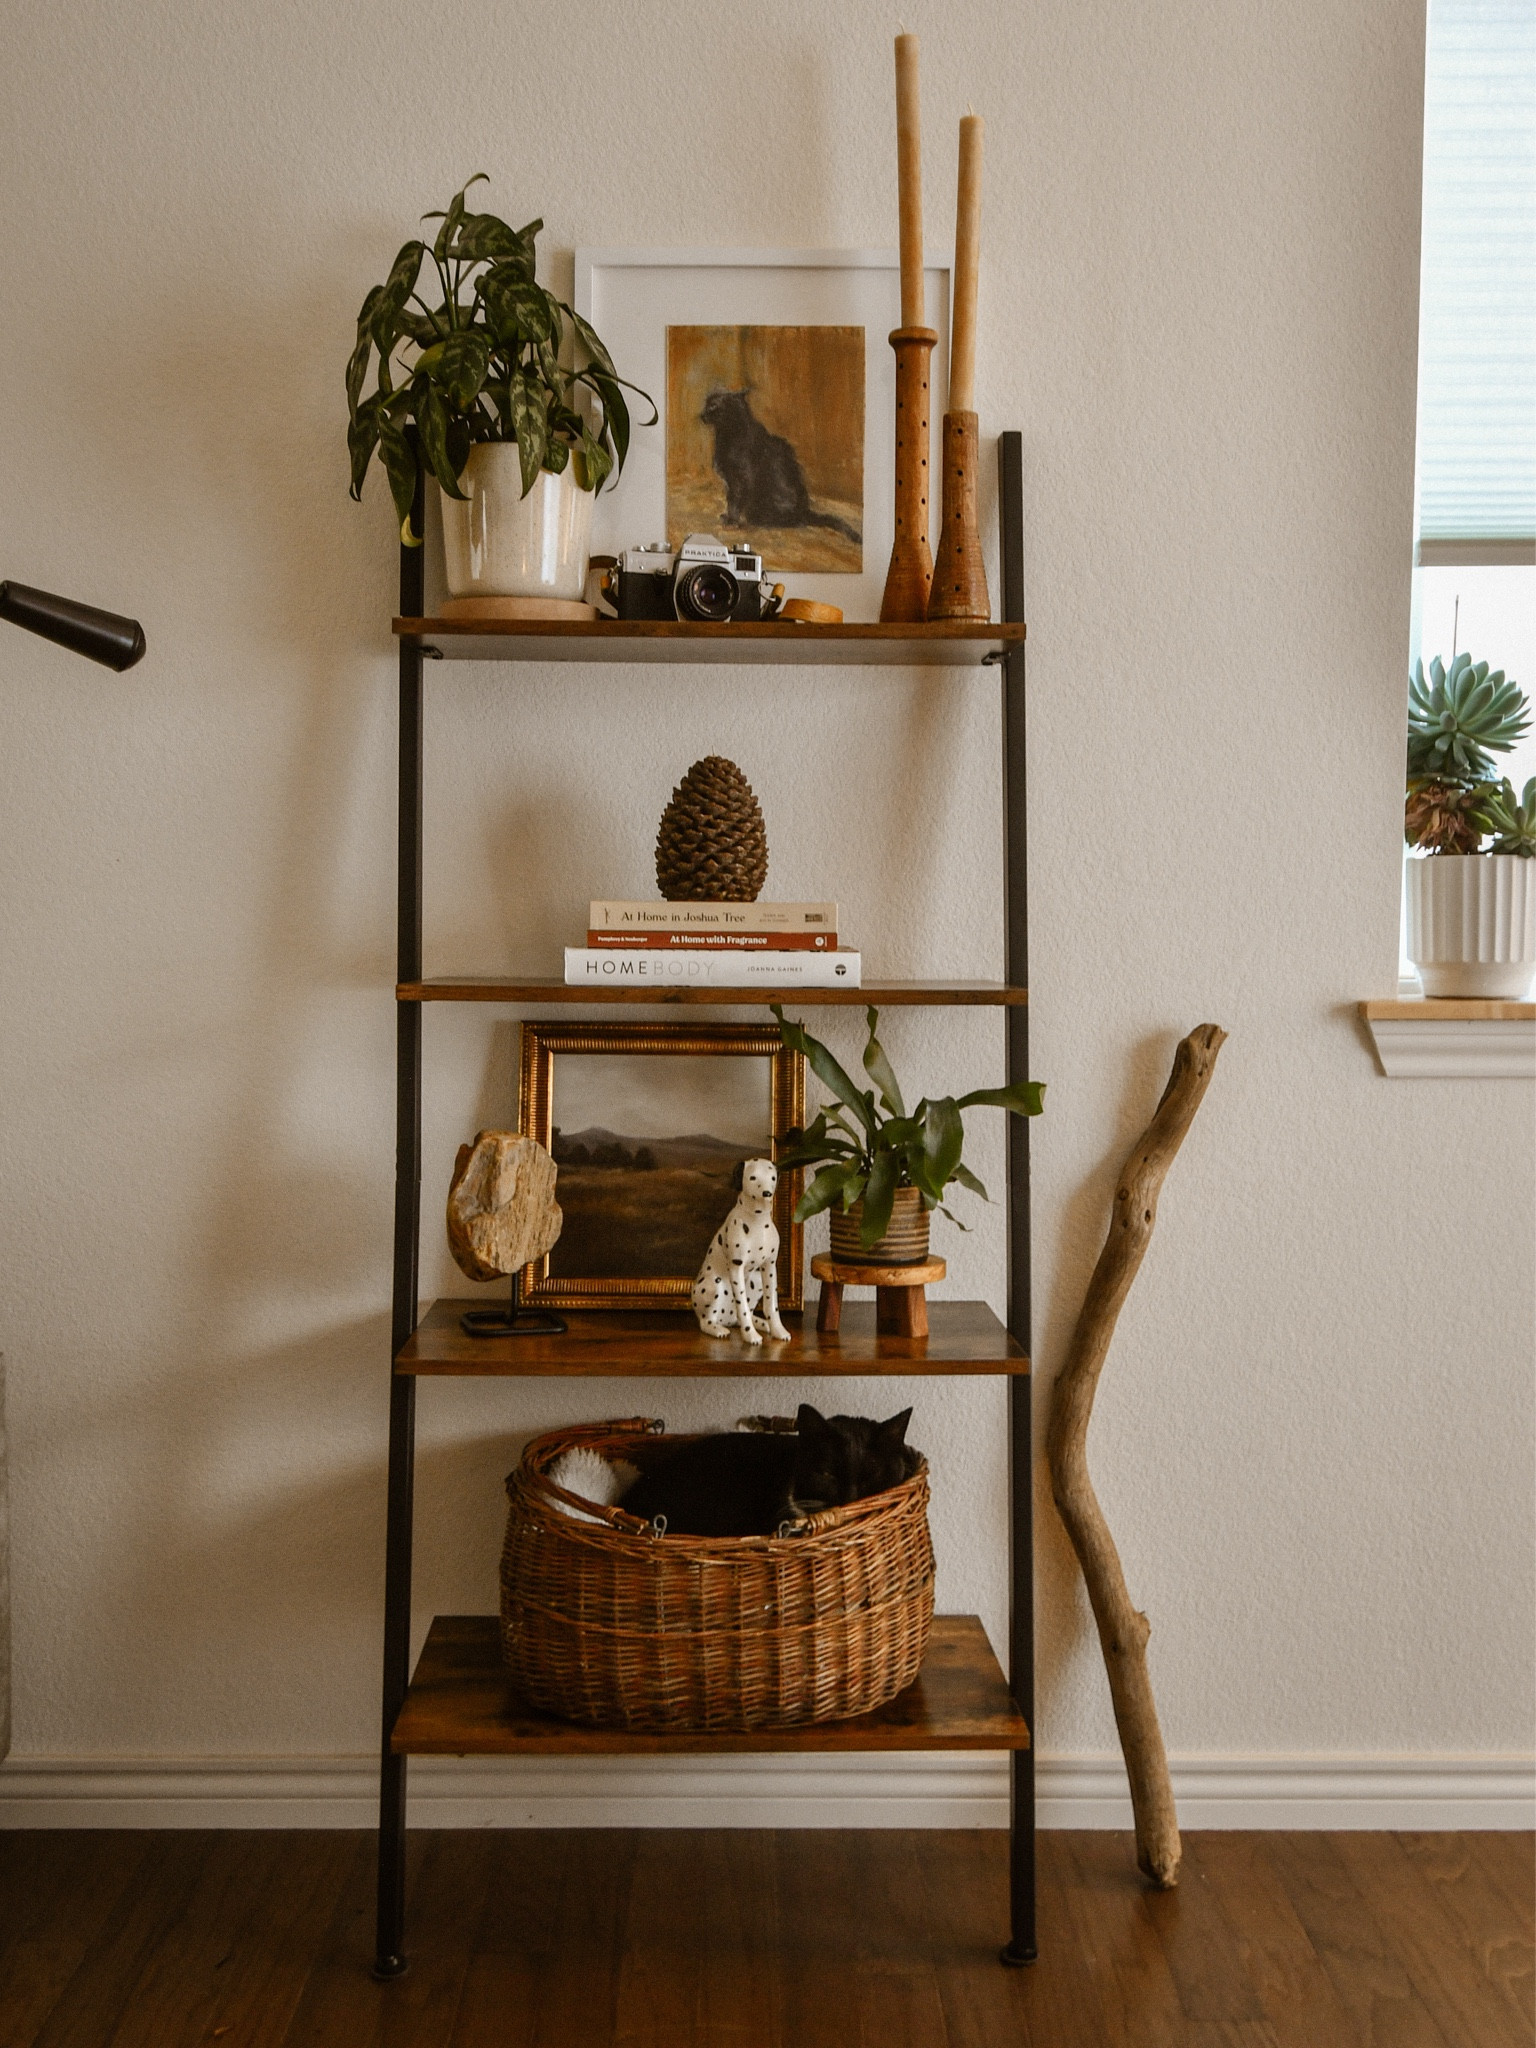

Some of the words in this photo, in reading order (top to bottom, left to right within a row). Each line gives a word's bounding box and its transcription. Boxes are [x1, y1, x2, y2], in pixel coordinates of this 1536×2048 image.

[684, 549, 727, 558] PRAKTICA
[621, 911, 634, 922] At
[637, 911, 668, 922] Home
[671, 912, 681, 922] in
[683, 911, 719, 922] Joshua
[723, 911, 746, 923] Tree
[670, 935, 680, 944] At
[681, 935, 706, 944] Home
[706, 935, 726, 944] with
[727, 935, 768, 946] Fragrance
[586, 960, 714, 977] HOMEBODY
